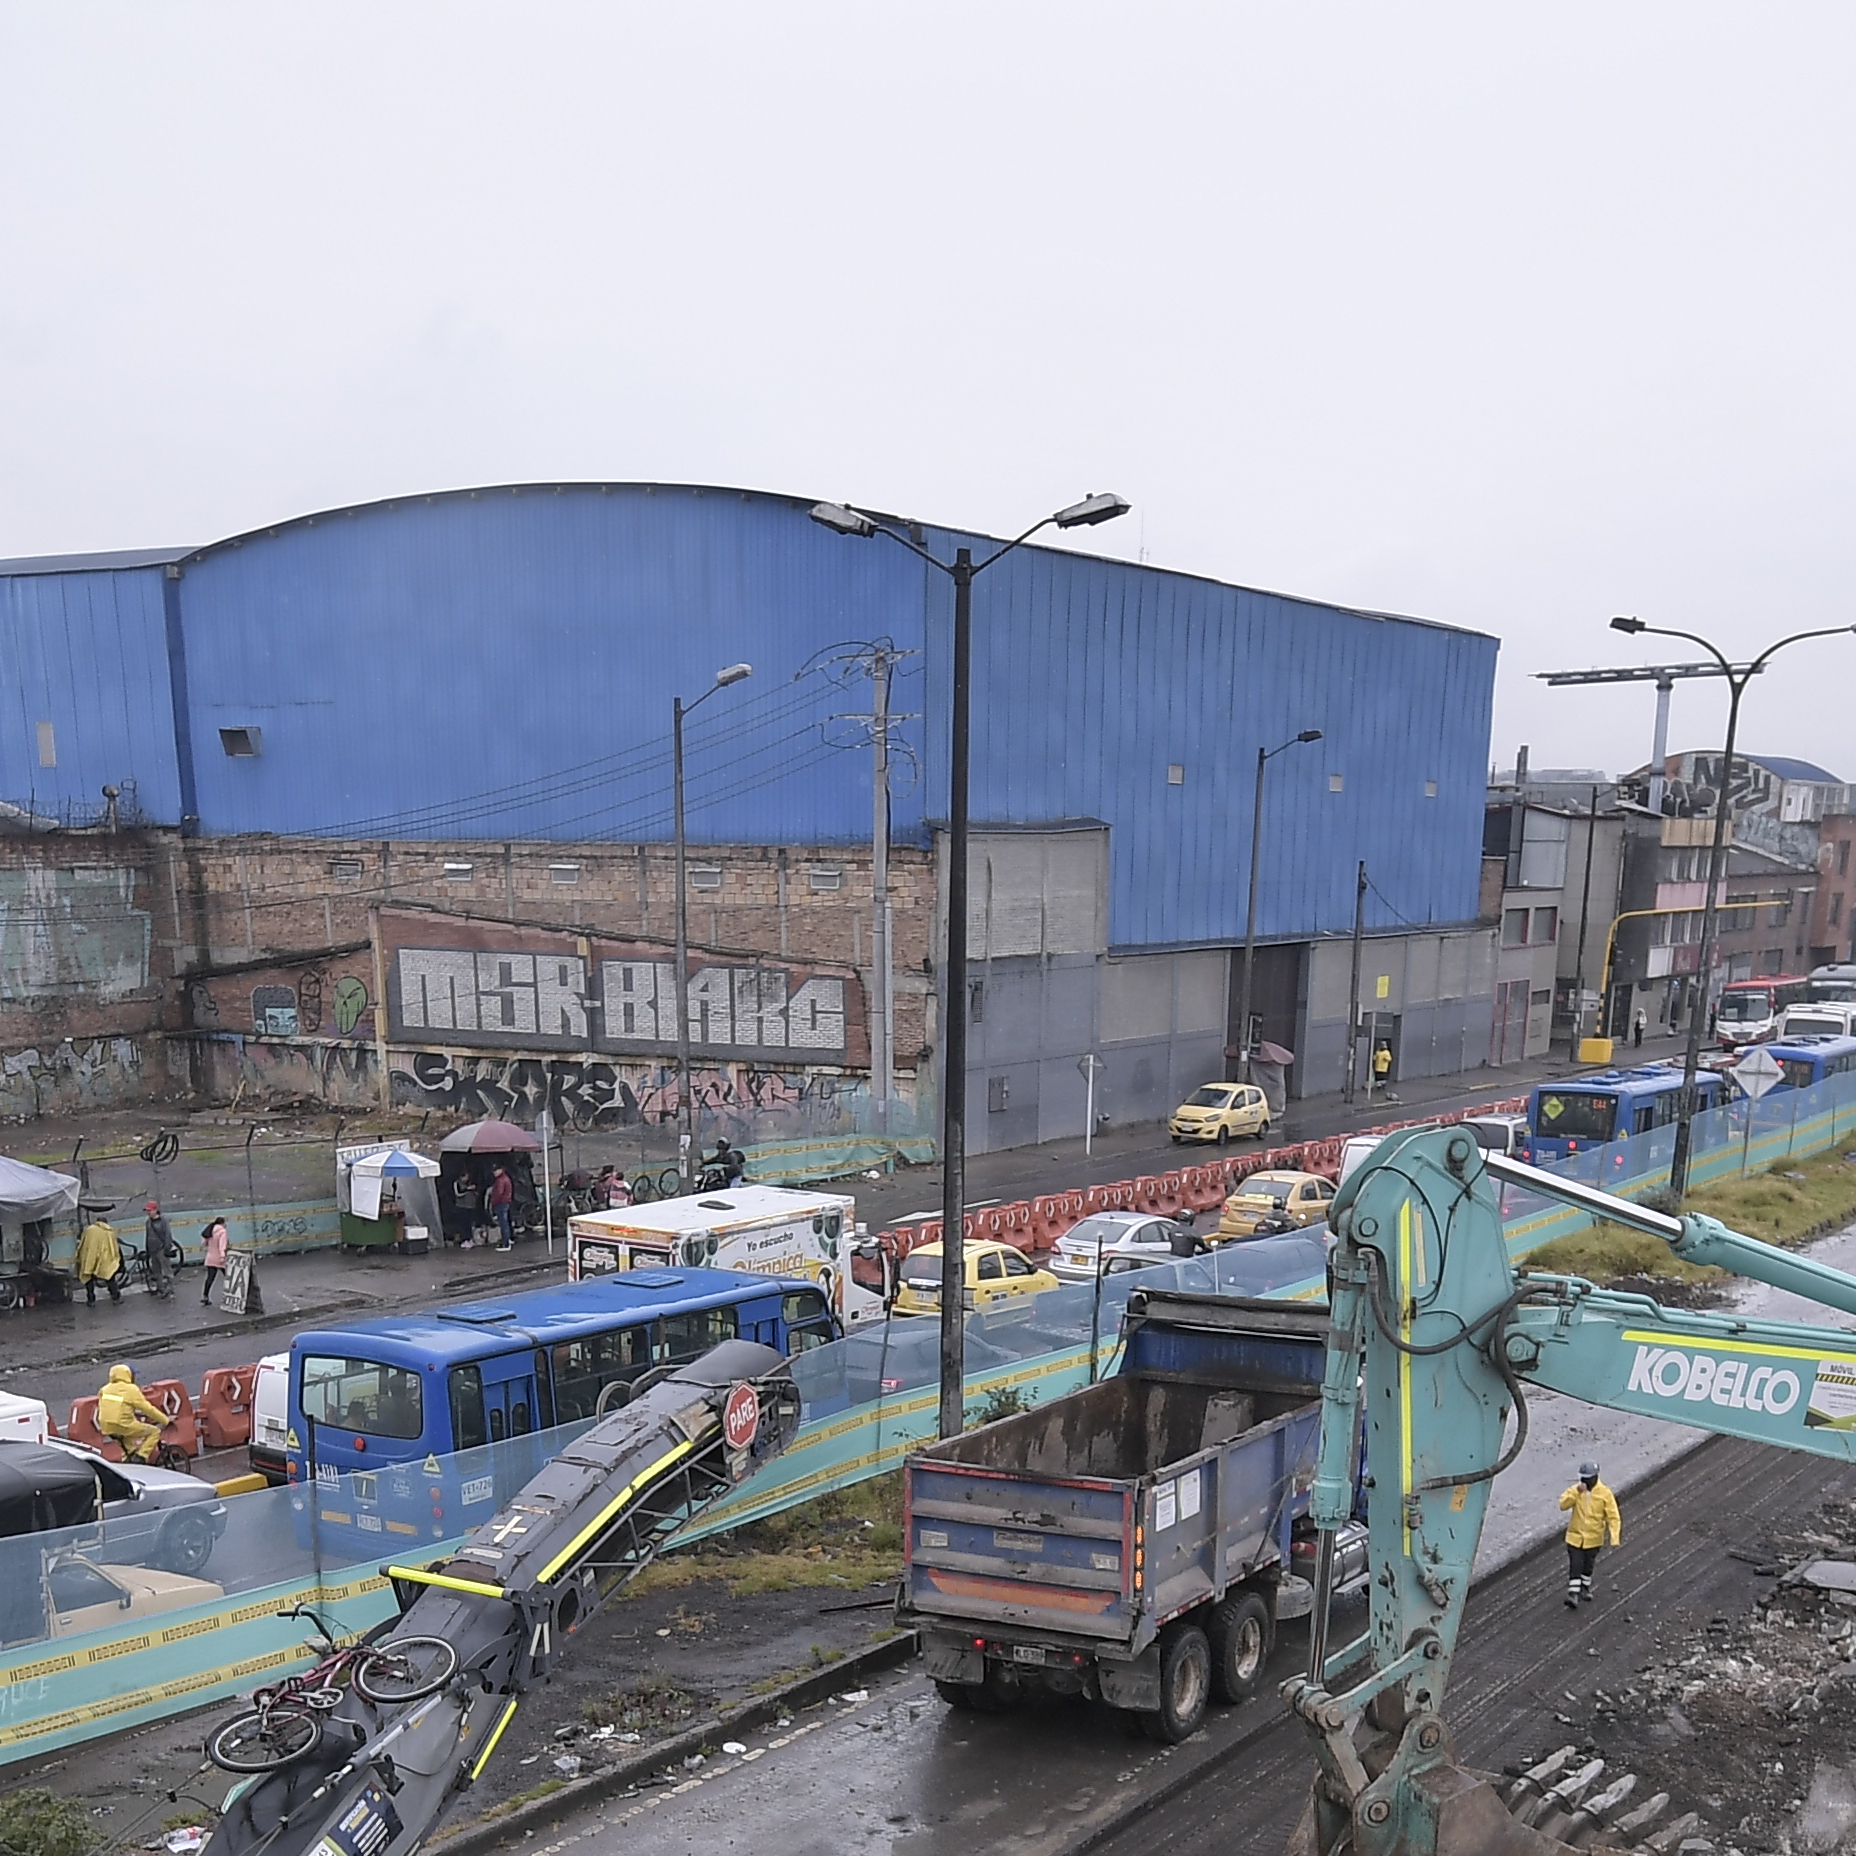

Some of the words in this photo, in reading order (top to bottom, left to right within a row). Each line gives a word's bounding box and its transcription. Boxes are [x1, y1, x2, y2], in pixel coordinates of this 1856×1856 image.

[1627, 1345, 1800, 1415] KOBELCO
[1829, 1364, 1855, 1376] MÓVIL
[730, 1397, 755, 1435] PARE
